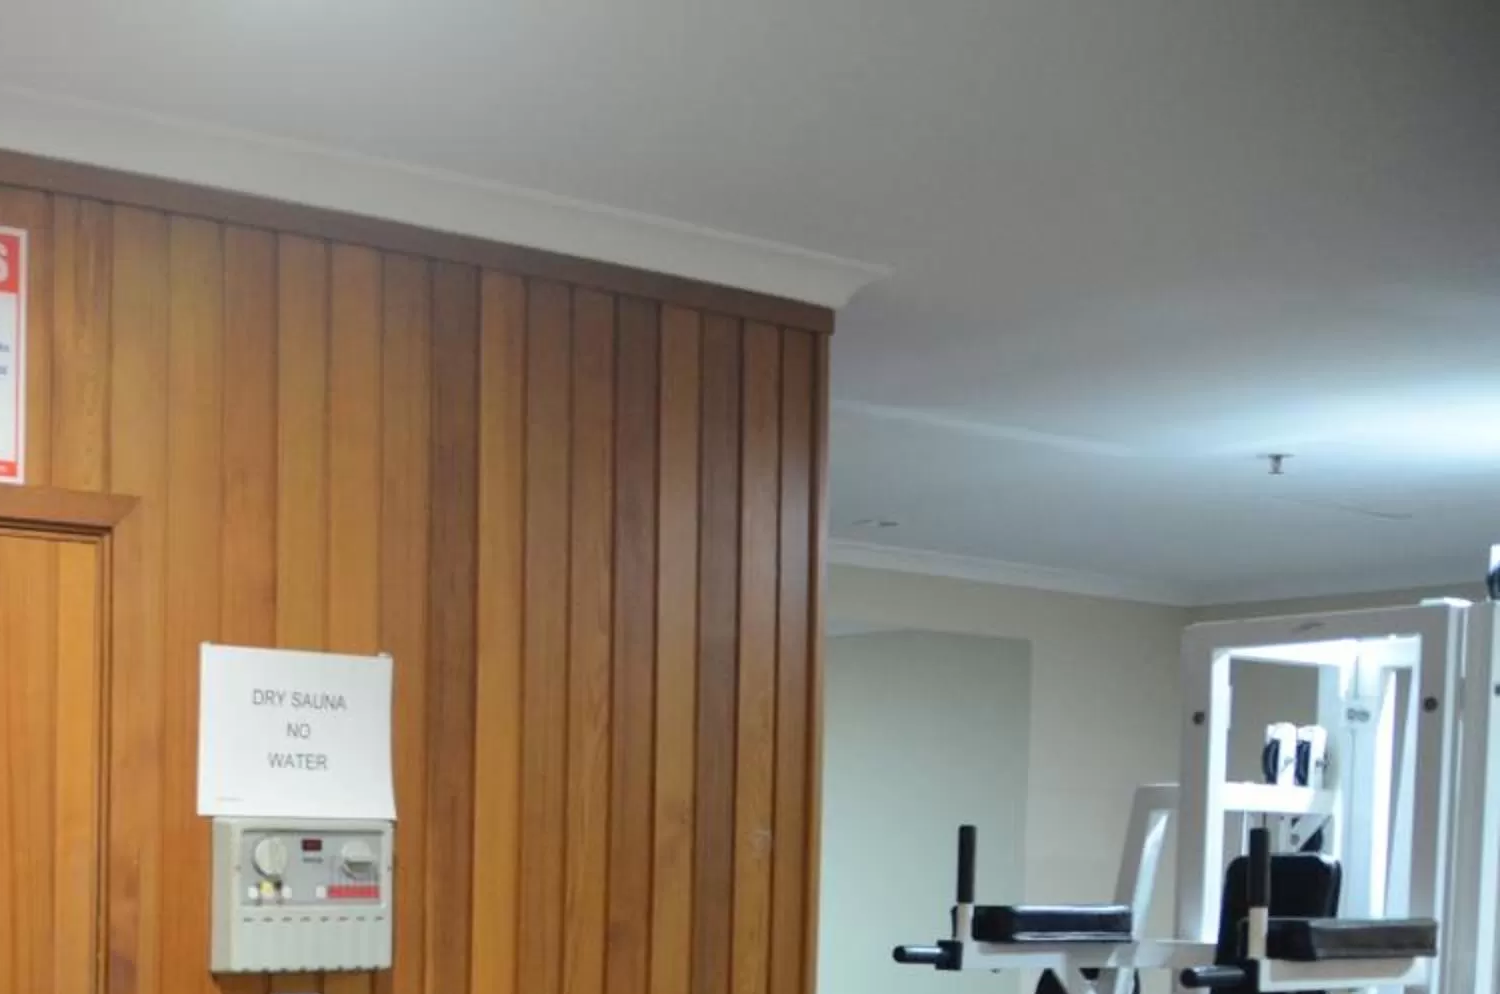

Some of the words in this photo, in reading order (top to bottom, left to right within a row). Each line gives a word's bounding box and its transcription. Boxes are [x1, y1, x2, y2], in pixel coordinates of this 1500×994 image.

[252, 688, 285, 706] DRY
[291, 691, 347, 711] SAUNA
[286, 722, 311, 739] NO
[267, 752, 328, 771] WATER
